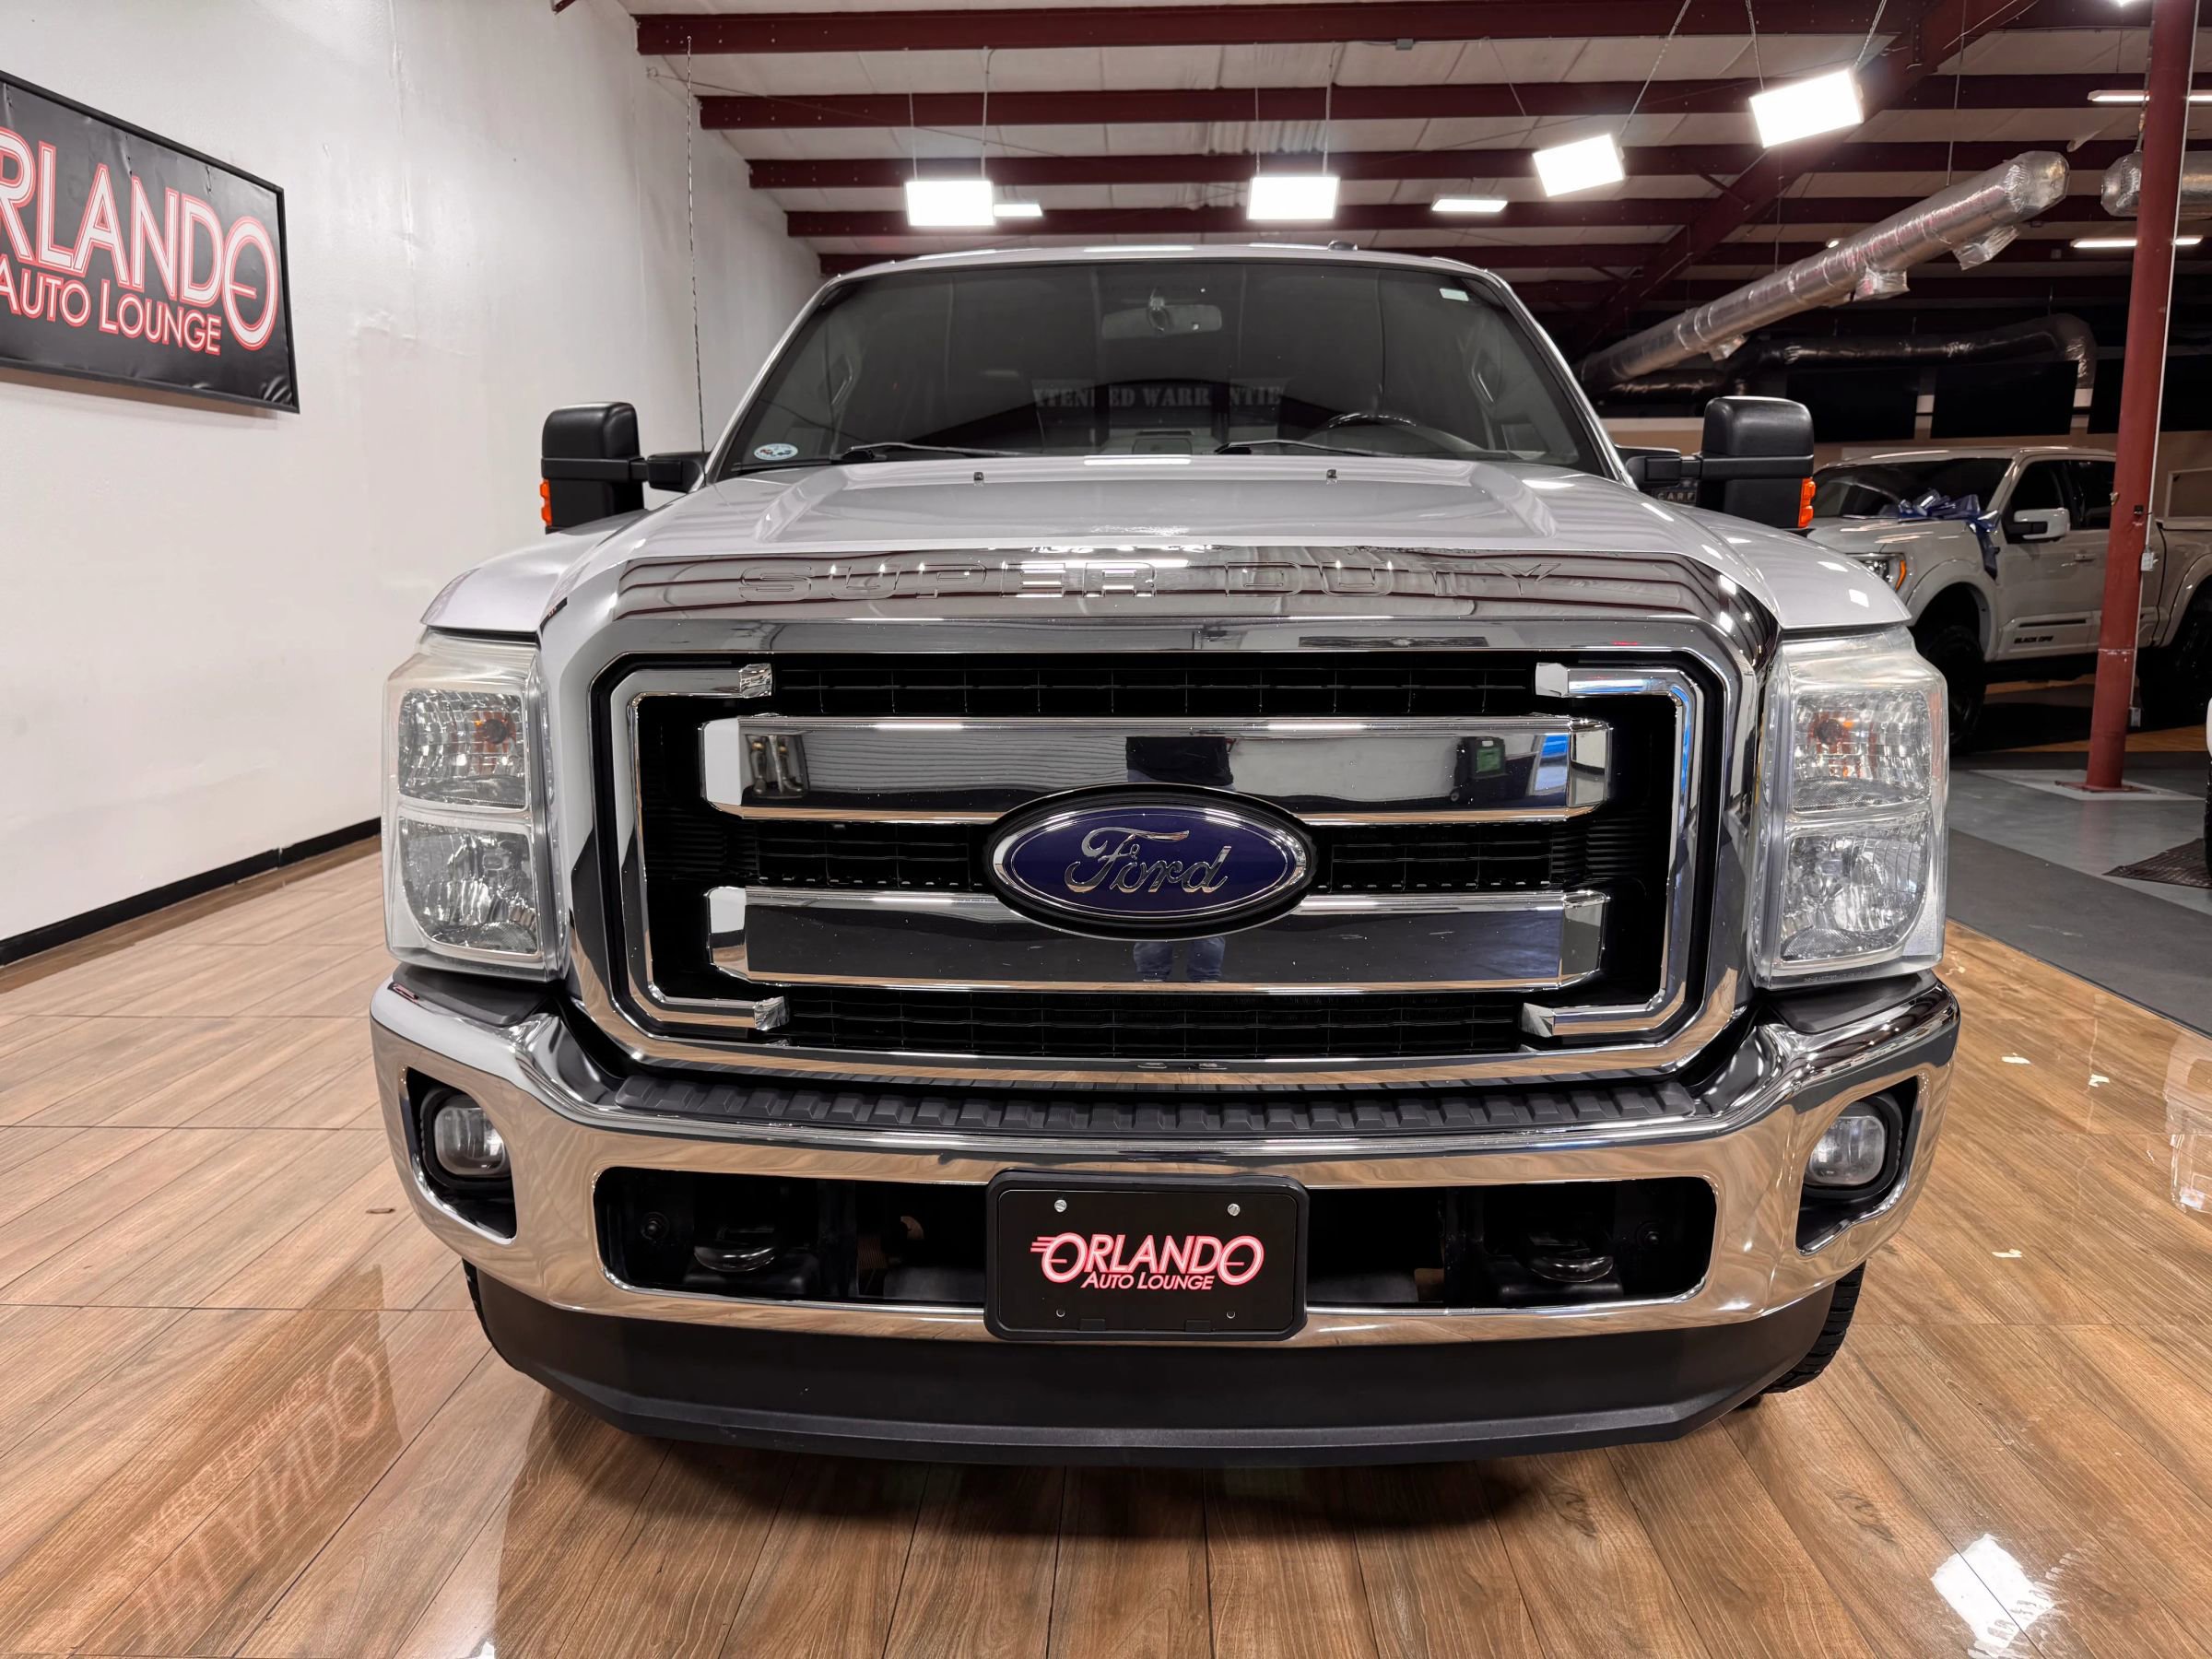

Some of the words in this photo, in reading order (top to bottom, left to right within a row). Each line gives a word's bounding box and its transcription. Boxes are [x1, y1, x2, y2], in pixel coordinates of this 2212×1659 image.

[0, 253, 91, 328] AUTO
[99, 279, 222, 356] LOUNGE
[738, 560, 1158, 602] SUPER
[1224, 560, 1562, 598] DUTY
[1065, 826, 1232, 894] Ford
[1030, 1231, 1265, 1286] ORLANDO
[1080, 1271, 1135, 1289] AUTO
[1136, 1271, 1216, 1290] LOUNGE
